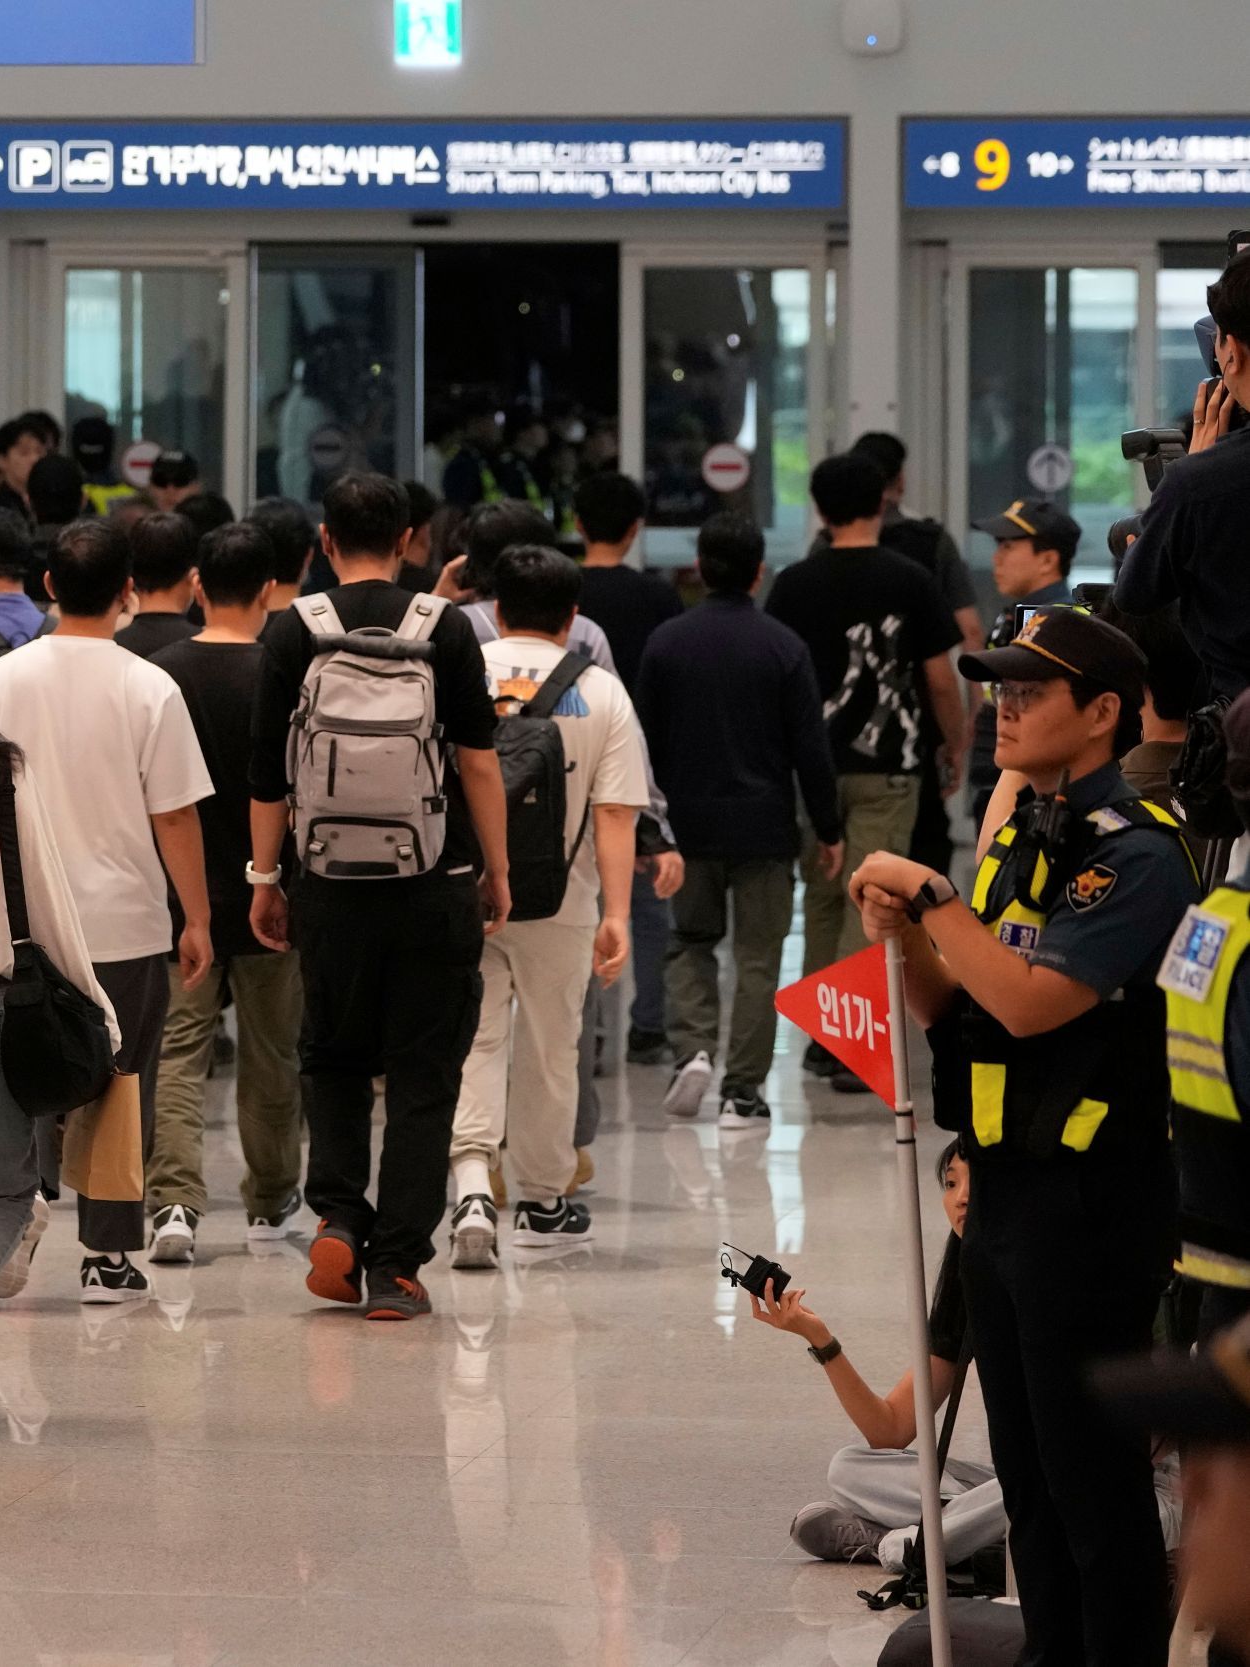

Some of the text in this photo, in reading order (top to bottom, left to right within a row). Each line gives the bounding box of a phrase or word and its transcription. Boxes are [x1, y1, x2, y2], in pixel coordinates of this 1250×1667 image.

[974, 139, 1011, 191] 9
[1026, 151, 1059, 178] 10
[758, 170, 791, 194] Bus
[1087, 169, 1132, 193] Free
[1132, 169, 1202, 193] Shuttle
